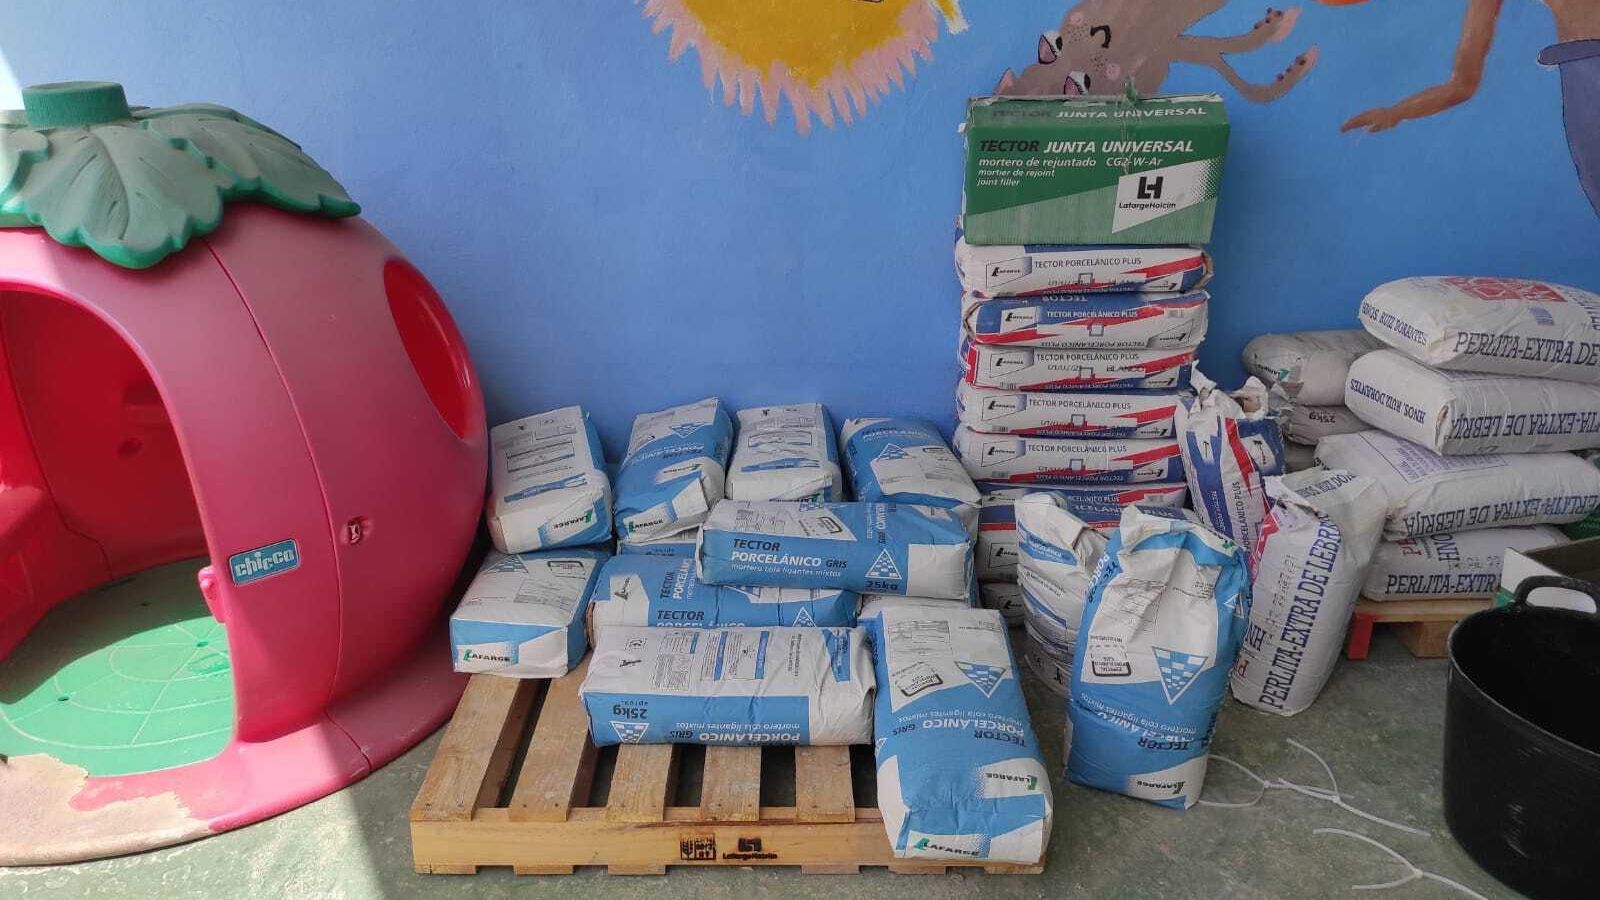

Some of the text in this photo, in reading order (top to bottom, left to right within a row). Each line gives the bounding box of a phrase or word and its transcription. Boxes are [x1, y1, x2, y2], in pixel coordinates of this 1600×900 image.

[1056, 110, 1108, 119] JUNTA
[1113, 107, 1208, 119] UNIVERSAL
[979, 140, 1195, 154] TECTOR JUNTA UNIVERSAL
[978, 158, 1024, 168] mortero
[1026, 157, 1041, 168] de
[1042, 157, 1097, 169] rejuntado
[978, 169, 1056, 179] mortier de rejoint
[976, 178, 1021, 187] joint filler
[1118, 201, 1177, 211] LafargeHolcim
[1034, 259, 1064, 269] TECTOR
[1122, 257, 1142, 265] PLUS
[1453, 331, 1573, 365] PERLITA-EXTRA
[1036, 353, 1064, 361] TECTOR
[1350, 378, 1386, 404] DORANTES
[1028, 398, 1057, 408] TECTOR
[1112, 402, 1132, 410] PLUS
[1503, 414, 1528, 437] DE
[1530, 411, 1600, 436] TA-EXTRA
[1028, 444, 1055, 452] TECTOR
[1108, 445, 1127, 453] PLUS
[1403, 494, 1600, 537] ERLITA-EXTRA DE LEBRIJA
[733, 538, 781, 552] TECTOR
[1430, 532, 1461, 562] HNO
[234, 550, 295, 577] chicco
[731, 550, 848, 569] PORCELÁNICO GRIS
[656, 610, 706, 621] TECTOR
[1258, 594, 1320, 709] PERLITA-EXTRA
[1297, 569, 1329, 597] DE
[463, 648, 511, 662] LAFARGE
[612, 707, 649, 721] 25kg
[706, 722, 742, 732] ligantes
[763, 722, 801, 731] mortero
[973, 729, 1027, 748] TECTOR
[1137, 736, 1190, 752] TECTOR
[985, 772, 1038, 791] LAFARGE
[914, 837, 981, 857] LAFARGE
